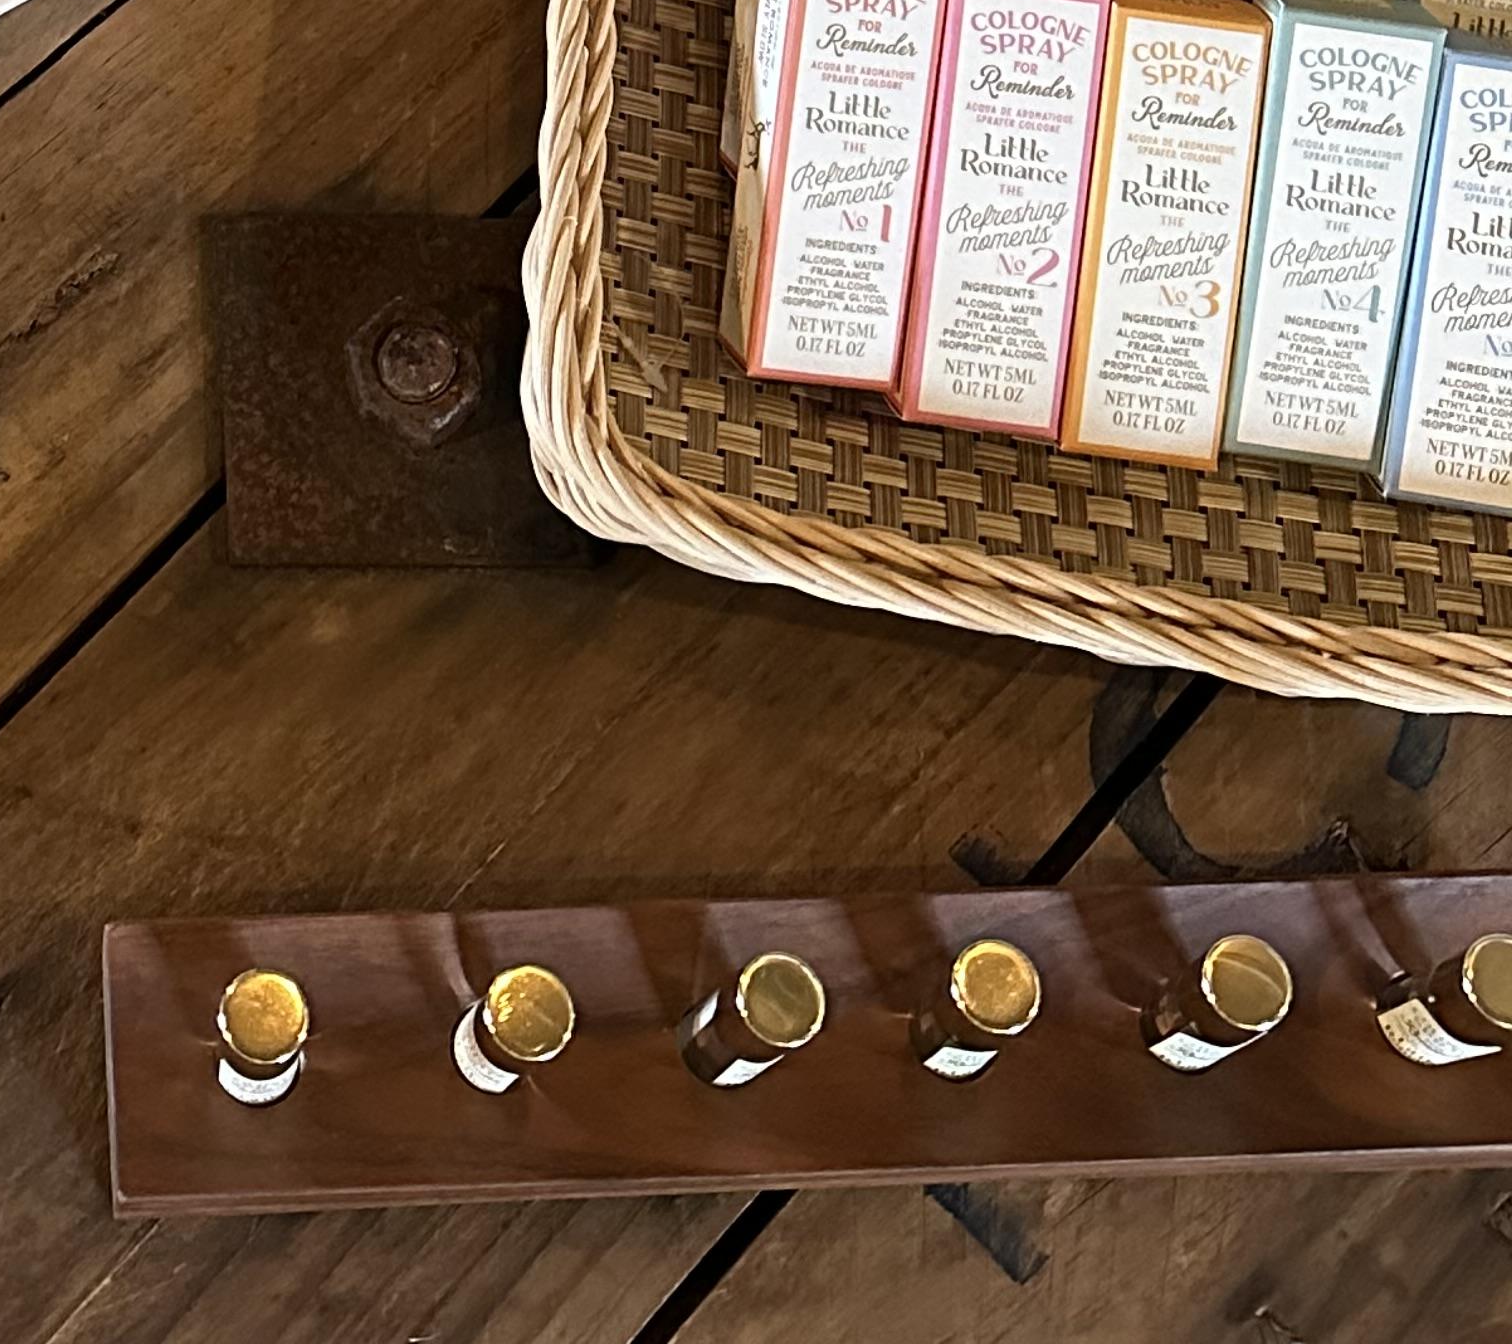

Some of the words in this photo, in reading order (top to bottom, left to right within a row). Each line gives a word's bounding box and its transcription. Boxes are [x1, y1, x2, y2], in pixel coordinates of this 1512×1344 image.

[817, 23, 917, 58] Reminder
[858, 19, 882, 33] FOR
[1142, 65, 1239, 95] SPRAY
[829, 90, 891, 119] Little
[1298, 102, 1405, 139] Reminder
[806, 107, 909, 142] Romance
[984, 133, 1049, 163] Little
[791, 157, 910, 193] Refreshing
[960, 149, 1068, 184] Romance
[1146, 164, 1211, 194] Little
[804, 182, 894, 210] moments
[1121, 180, 1229, 216] Romance
[1286, 185, 1396, 222] Romance
[880, 205, 892, 242] 1
[947, 200, 1068, 234] Refreshing
[959, 224, 1053, 253] moments
[1107, 231, 1230, 266] Refreshing
[1027, 247, 1060, 288] 2
[1283, 261, 1380, 288] moments
[1189, 279, 1220, 319] 3
[1351, 284, 1385, 323] 4
[788, 315, 820, 332] NET
[820, 319, 846, 334] WT
[847, 322, 878, 339] 5ML
[796, 336, 822, 352] 0.17
[826, 339, 841, 355] FL
[847, 341, 866, 356] OZ
